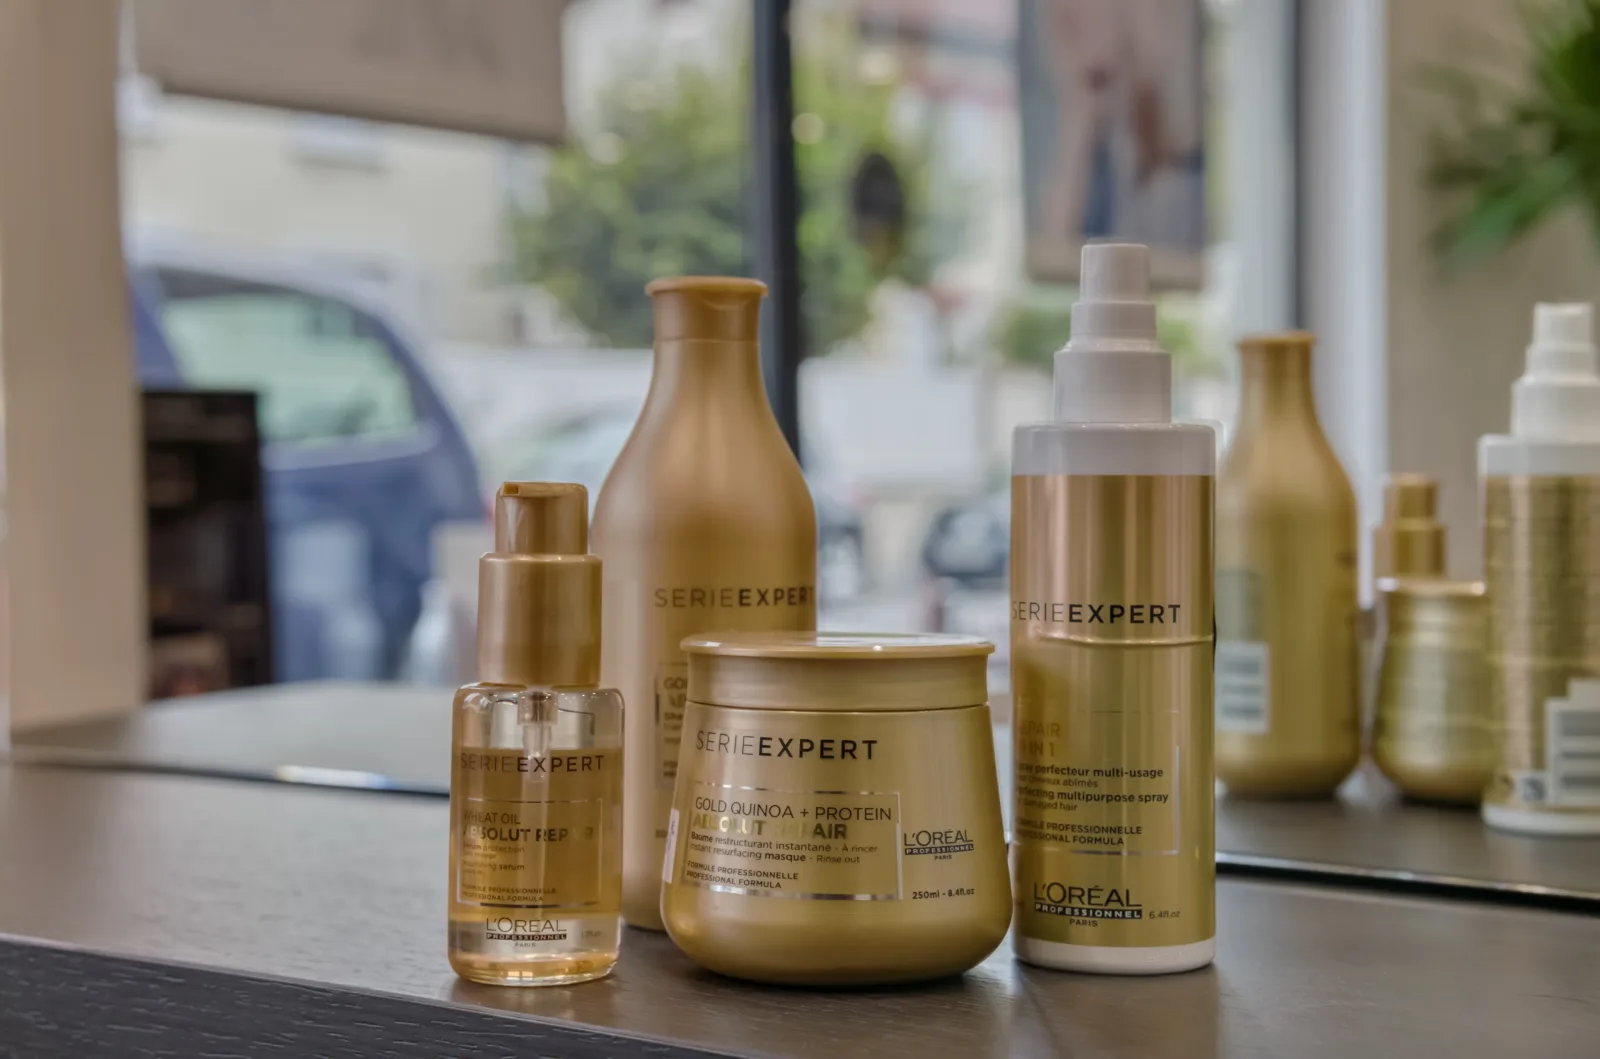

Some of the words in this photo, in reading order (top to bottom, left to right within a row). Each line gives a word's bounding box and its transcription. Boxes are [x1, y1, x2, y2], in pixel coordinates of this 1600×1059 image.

[696, 730, 878, 761] SERIEEXPERT
[460, 752, 605, 773] SERIEEXPERT
[1035, 765, 1090, 777] perfecteur
[1093, 767, 1165, 780] multi-usage
[1057, 792, 1135, 804] multipurpose
[1138, 793, 1169, 804] spray
[695, 797, 727, 813] GOLD
[731, 801, 794, 819] QUINOA
[815, 807, 892, 822] PROTEIN
[1060, 801, 1078, 811] hair
[501, 812, 521, 825] OIL
[1046, 822, 1142, 835] PROFESSIONNELLE
[691, 831, 713, 844] Baume
[715, 836, 773, 850] restructurant
[775, 842, 832, 853] instantané
[852, 846, 878, 854] rincer
[1073, 835, 1124, 846] FORMULA
[713, 846, 763, 861] resurfacing
[764, 851, 807, 863] masque
[816, 854, 842, 864] Rinse
[844, 855, 861, 864] out
[905, 843, 975, 855] PROFESSIONNEL
[687, 860, 716, 874] FORMULE
[717, 865, 800, 881] PROFESSIONNELLE
[686, 870, 737, 886] PROFESSIONAL
[738, 878, 783, 890] FORMULA
[912, 890, 940, 900] 250ml
[1034, 902, 1143, 920] PROFESSIONNEL
[1069, 918, 1098, 927] PARIS
[486, 932, 568, 941] PROFESSIONNEL
